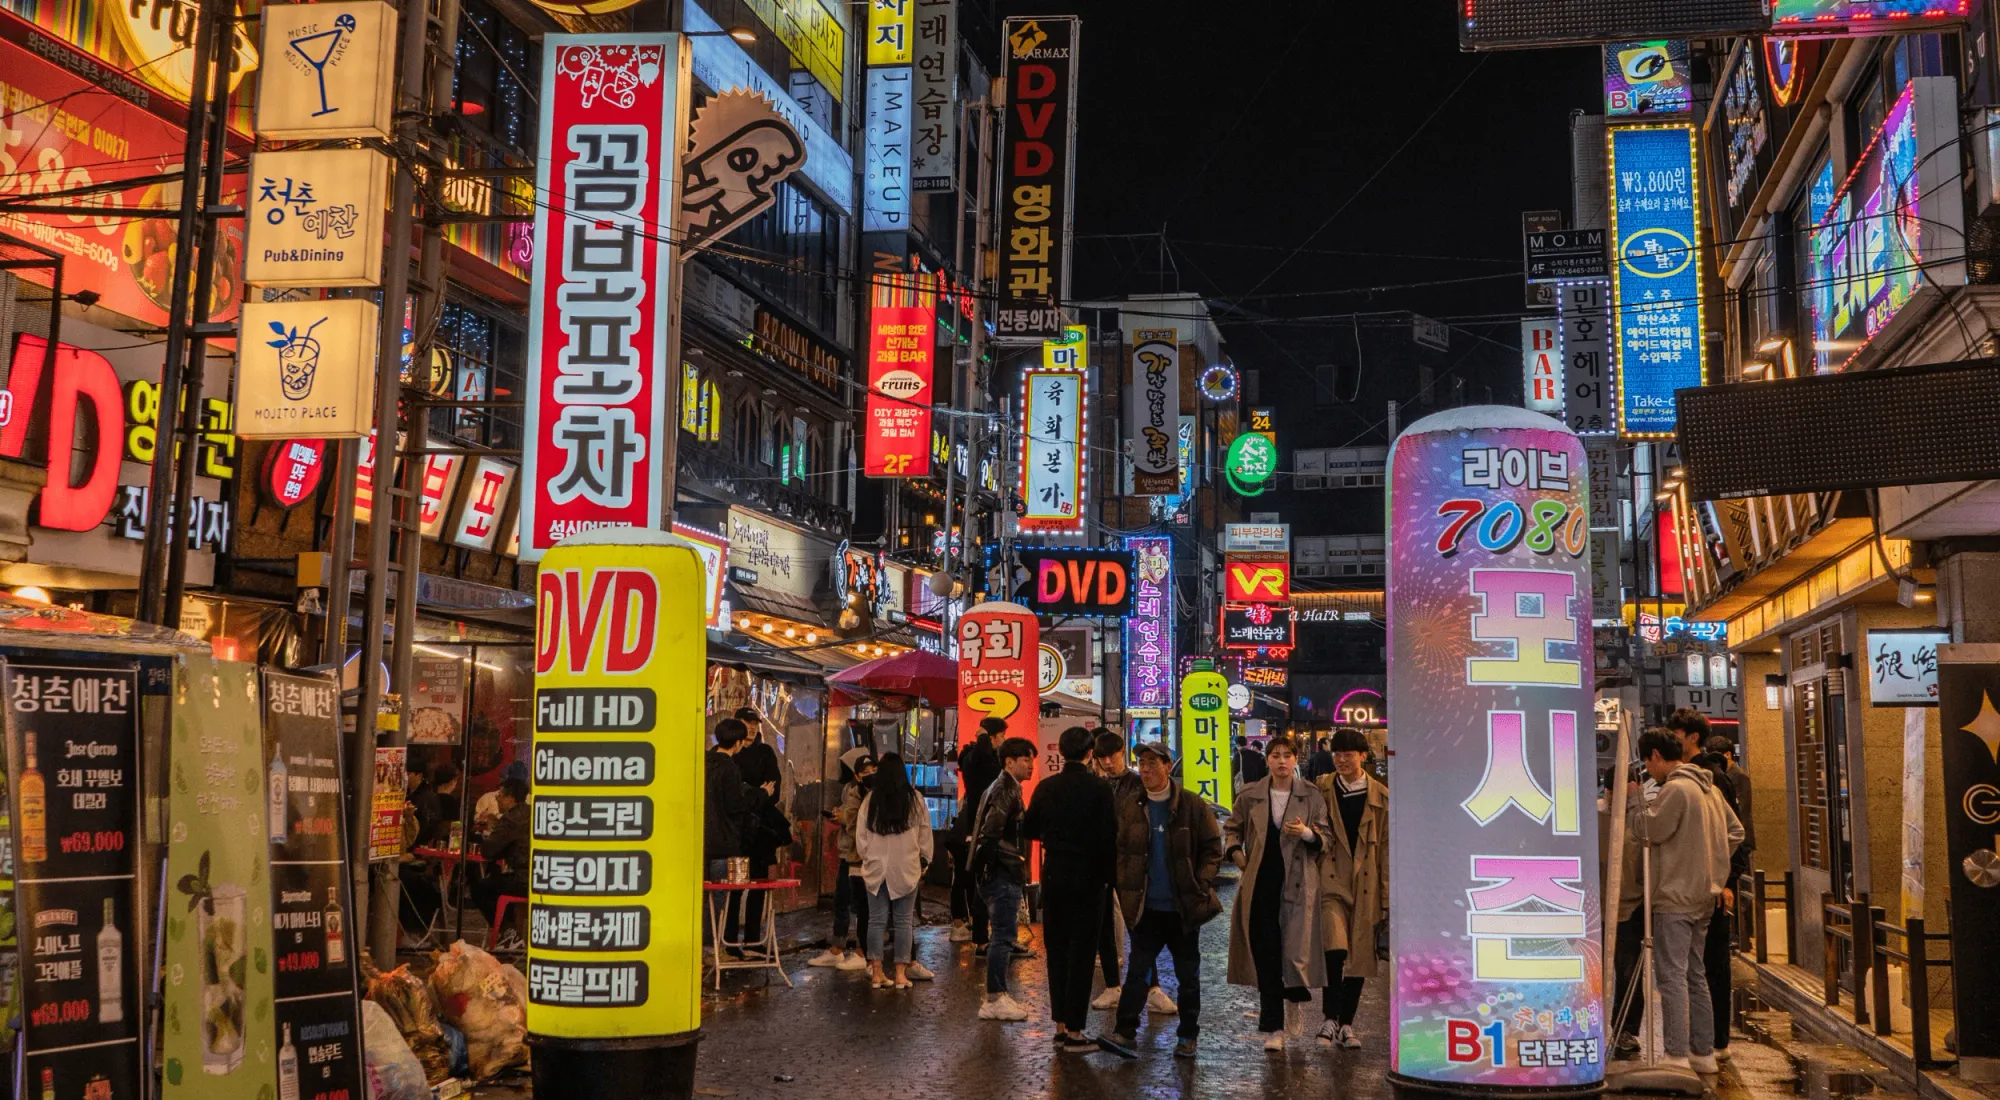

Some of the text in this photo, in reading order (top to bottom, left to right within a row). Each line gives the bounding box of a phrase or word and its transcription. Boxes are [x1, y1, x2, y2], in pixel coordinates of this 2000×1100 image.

[288, 23, 319, 38] MUSIC
[330, 37, 350, 67] PLACE
[895, 53, 906, 61] 4F
[1012, 47, 1069, 60] STARMAX
[915, 0, 948, 156] 래연습장
[1609, 89, 1638, 111] B1
[53, 107, 90, 146] 두번째
[93, 127, 129, 160] 이야기
[1008, 64, 1057, 301] DVD 영화관
[1622, 166, 1687, 198] ₩3,800원
[258, 177, 359, 240] 청춘 예찬
[263, 249, 344, 263] Pub&Dining
[552, 130, 643, 500] 꼼보포차
[999, 309, 1061, 332] 진동의자
[1636, 313, 1681, 326] 탄산소주
[762, 311, 840, 393] BROWN CITY
[877, 350, 927, 363] 과일 BAR
[886, 336, 919, 349] 신개념
[1571, 287, 1600, 409] 민호헤어
[1531, 328, 1555, 400] BAR
[255, 405, 338, 421] MOJITO PLACE
[874, 408, 893, 417] DIY
[1252, 416, 1272, 430] 24
[1574, 414, 1604, 430] 2층
[1039, 380, 1065, 509] 육회본가
[883, 453, 913, 474] 2F
[1463, 448, 1569, 491] 라이브
[1231, 527, 1285, 539] 피부관리샵
[1436, 499, 1587, 556] 7080
[1037, 558, 1127, 606] DVD
[1231, 567, 1285, 597] VR
[536, 569, 659, 675] DVD
[1137, 579, 1162, 687] 노래연습장
[1230, 626, 1286, 641] 노래연습장
[962, 618, 1022, 669] 육회
[12, 674, 131, 714] 청춘예찬
[961, 669, 1025, 688] 18,000원
[269, 679, 333, 719] 청춘예찬
[538, 694, 645, 727] Full HD
[1191, 696, 1219, 708] 넥타이
[535, 749, 646, 781] Cinema
[1194, 716, 1220, 804] 마사지
[1460, 568, 1587, 981] 포시즌
[534, 801, 643, 836] 대형스크린
[533, 855, 642, 892] 진동의자
[531, 908, 641, 947] 영화+팝콘+커피
[530, 963, 638, 1003] 무료셀프바
[1446, 1018, 1506, 1068] B1
[1518, 1037, 1599, 1067] 단란주점
